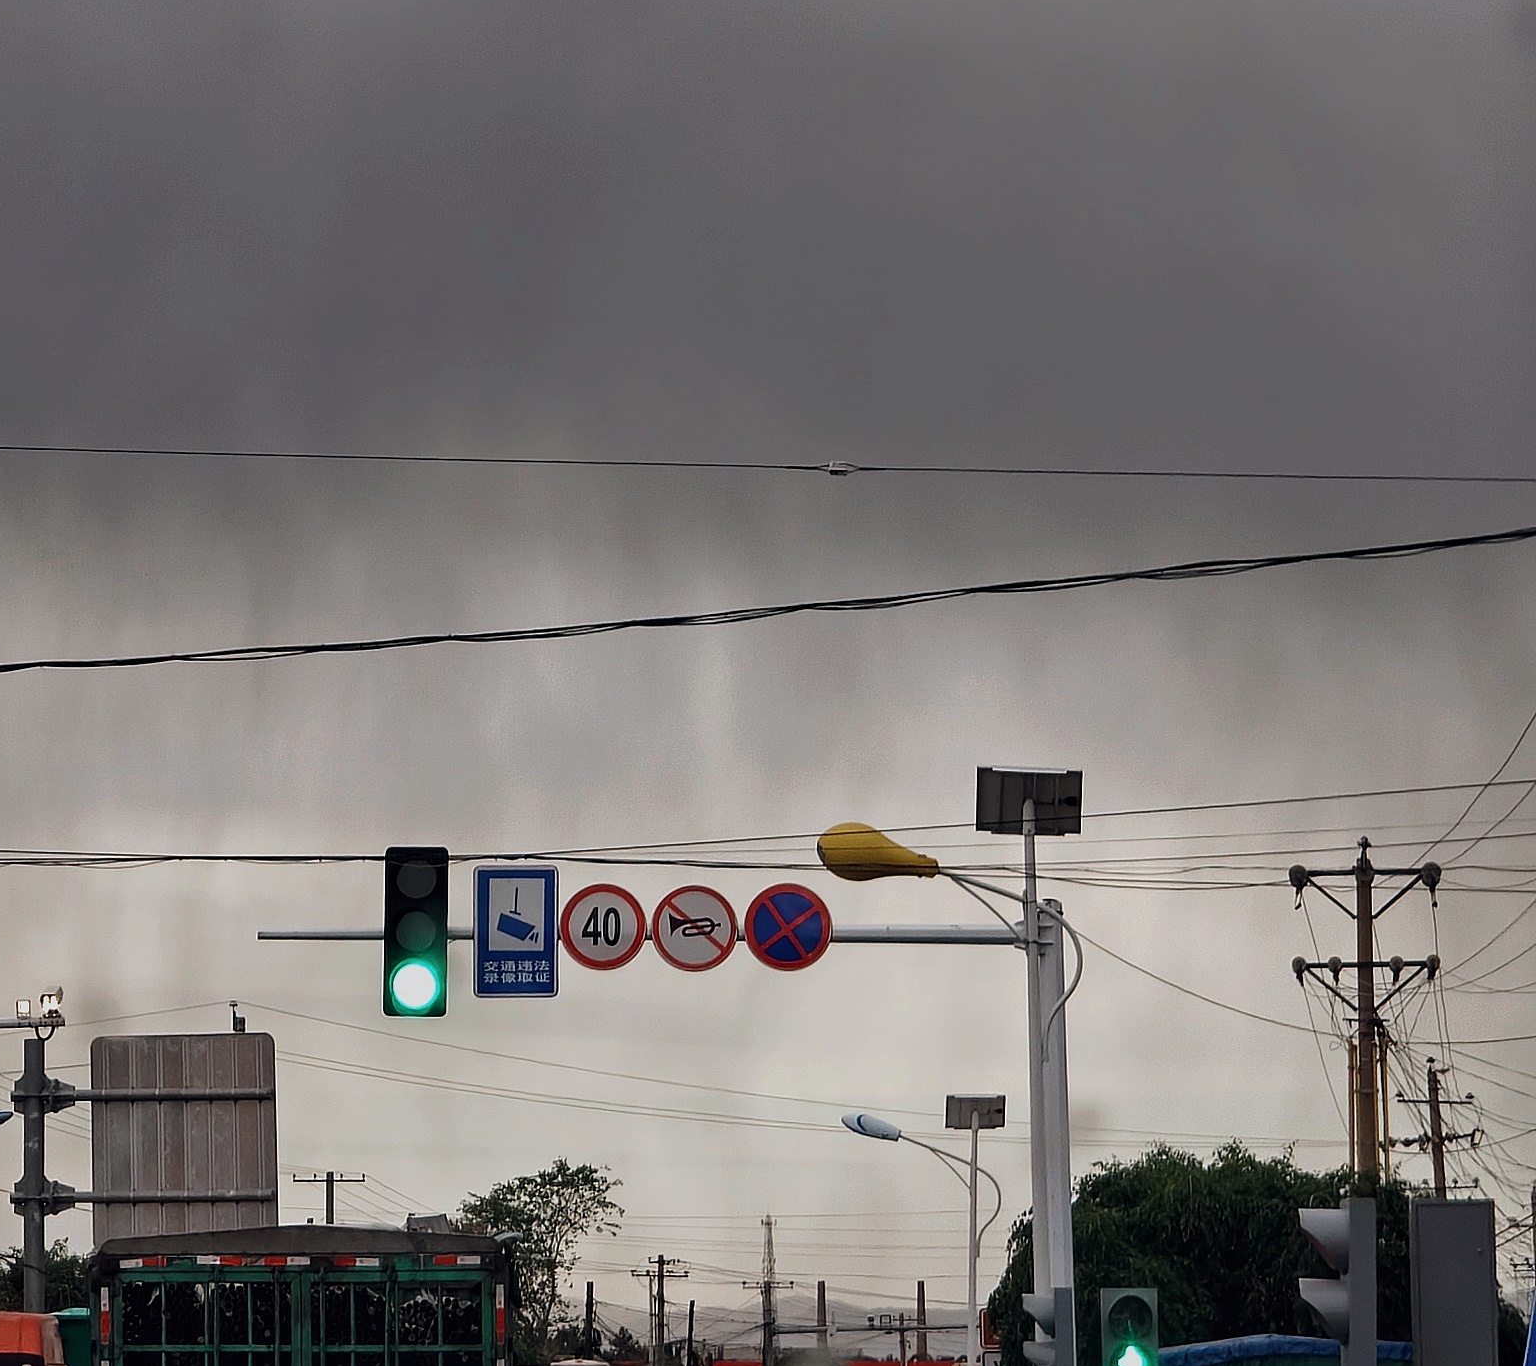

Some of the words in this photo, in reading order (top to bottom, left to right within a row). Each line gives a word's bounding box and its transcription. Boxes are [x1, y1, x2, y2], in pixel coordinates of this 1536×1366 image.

[581, 906, 622, 947] 40
[483, 960, 550, 972] 交通违法
[483, 972, 550, 984] 录像取证
